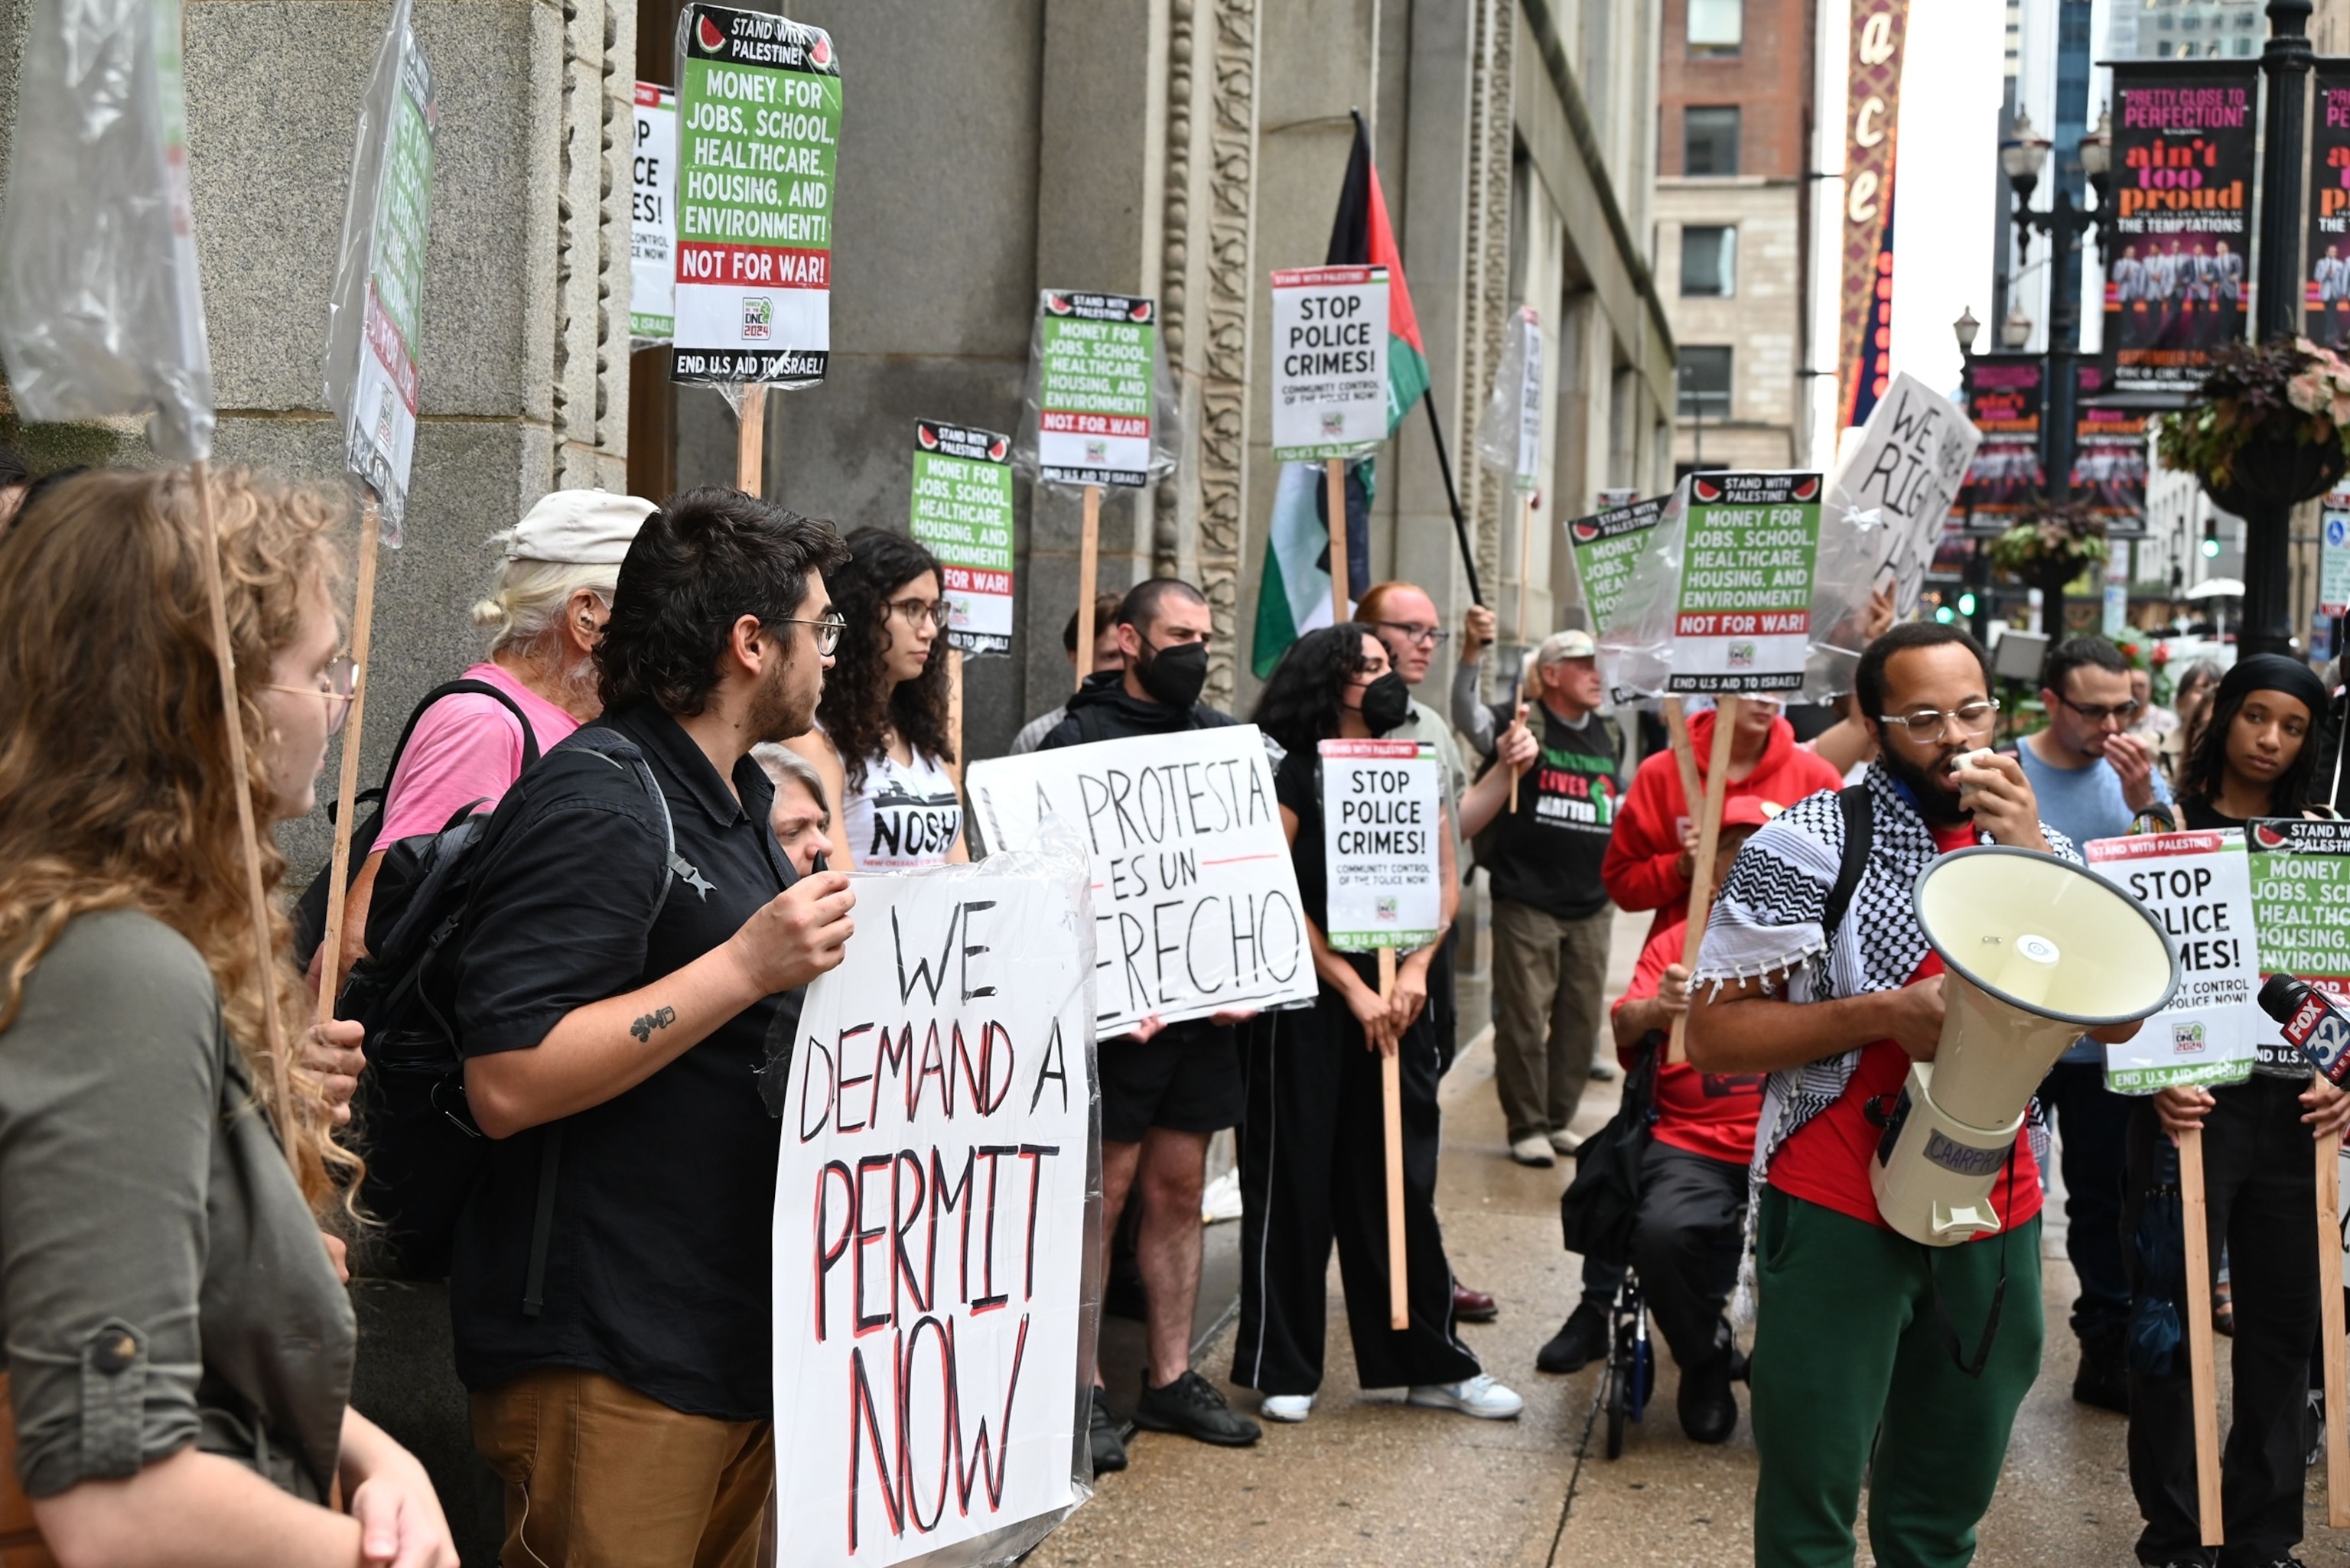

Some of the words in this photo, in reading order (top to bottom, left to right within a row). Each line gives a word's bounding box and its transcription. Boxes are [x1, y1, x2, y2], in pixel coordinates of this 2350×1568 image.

[731, 18, 772, 39] STAND
[775, 24, 806, 45] WITH
[732, 40, 802, 66] PALESTINE!
[707, 69, 777, 103] MONEY
[785, 79, 822, 109] FOR
[2180, 88, 2223, 106] CLOSE
[2228, 88, 2246, 106] TO
[686, 102, 748, 137] JOBS,
[2139, 165, 2202, 189] too
[688, 171, 782, 207] HOUSING,
[789, 181, 827, 209] AND
[2119, 180, 2243, 217] proud
[685, 206, 826, 242] ENVIRONMENT!
[2117, 218, 2143, 233] THE
[2147, 218, 2243, 233] TEMPTATIONS
[2319, 218, 2346, 232] THE
[643, 247, 668, 261] NOW!
[682, 249, 725, 278] NOT
[733, 252, 773, 281] FOR
[779, 255, 825, 283] WAR!
[1073, 295, 1105, 307] STAND
[1106, 298, 1129, 309] WITH
[1300, 295, 1361, 320] STOP
[640, 316, 673, 333] ISRAEL!
[745, 313, 763, 324] DNC
[744, 325, 768, 337] 2024
[1059, 322, 1108, 340] MONEY
[1112, 326, 1140, 343] FOR
[1291, 323, 1370, 349] POLICE
[677, 355, 705, 374] END
[735, 356, 757, 374] AID
[761, 357, 776, 374] TO
[778, 357, 824, 375] ISRAEL!
[1284, 350, 1375, 377] CRIMES!
[1117, 380, 1147, 396] AND
[1282, 383, 1334, 395] COMMUNITY
[1339, 381, 1379, 391] CONTROL
[1046, 392, 1146, 415] ENVIRONMENT!
[1284, 396, 1295, 405] OF
[1044, 413, 1075, 430] NOT
[1079, 415, 1106, 432] FOR
[1110, 418, 1146, 436] WAR!
[1892, 389, 1941, 455] WE
[939, 428, 965, 443] STAND
[967, 431, 988, 447] WITH
[927, 458, 969, 480] MONEY
[973, 466, 998, 485] FOR
[1099, 471, 1110, 482] TO
[1724, 478, 1762, 490] STAND
[1765, 477, 1792, 489] WITH
[1727, 490, 1787, 503] PALESTINE!
[1598, 509, 1631, 526] STAND
[1633, 502, 1659, 516] WITH
[1705, 509, 1766, 528] MONEY
[1769, 509, 1803, 526] FOR
[979, 528, 1007, 547] AND
[1591, 535, 1642, 561] MONEY
[919, 540, 1008, 568] VIRONMENT!
[944, 568, 968, 588] FOR
[972, 572, 1009, 593] WAR!
[1772, 570, 1808, 586] AND
[1684, 590, 1807, 608] ENVIRONMENT!
[1680, 616, 1717, 633] NOT
[1722, 615, 1756, 633] FOR
[1761, 614, 1805, 631] WAR!
[963, 635, 975, 647] TO
[1673, 678, 1697, 688] END
[1720, 677, 1741, 688] AID
[1743, 677, 1759, 688] TO
[1761, 675, 1801, 688] ISRAEL!
[1352, 770, 1409, 793] STOP
[1078, 757, 1270, 855] PROTESTA
[1343, 801, 1421, 824] POLICE
[2290, 824, 2335, 838] STAND
[1338, 831, 1425, 854] CRIMES!
[2091, 845, 2127, 856] STAND
[2129, 842, 2156, 854] WITH
[2158, 838, 2212, 851] PALESTINE!
[1111, 854, 1148, 900] ES
[1160, 848, 1196, 890] UN
[1336, 864, 1387, 873] COMMUNITY
[1391, 864, 1430, 873] CONTROL
[2270, 859, 2342, 880] MONEY
[1339, 877, 1349, 885] OF
[2130, 868, 2212, 901] STOP
[2150, 903, 2230, 935] LICE
[2259, 904, 2350, 926] HEALTHC
[1332, 935, 1351, 945] END
[1371, 934, 1388, 945] AID
[1389, 934, 1402, 944] TO
[892, 900, 997, 1007] WE
[1096, 890, 1300, 1021] ERECHO
[2193, 979, 2249, 994] CONTROL
[2169, 997, 2210, 1010] POLICE
[2215, 993, 2247, 1004] NOW!
[2288, 999, 2322, 1040] FOX
[2176, 1043, 2202, 1051] 2024
[2306, 1015, 2348, 1066] 32
[799, 1018, 1014, 1143] DEMAND
[1028, 1017, 1068, 1118] A
[2114, 1074, 2140, 1086] END
[2172, 1068, 2192, 1083] AID
[814, 1143, 1060, 1345] PERMIT
[848, 1312, 1030, 1557] NOW
